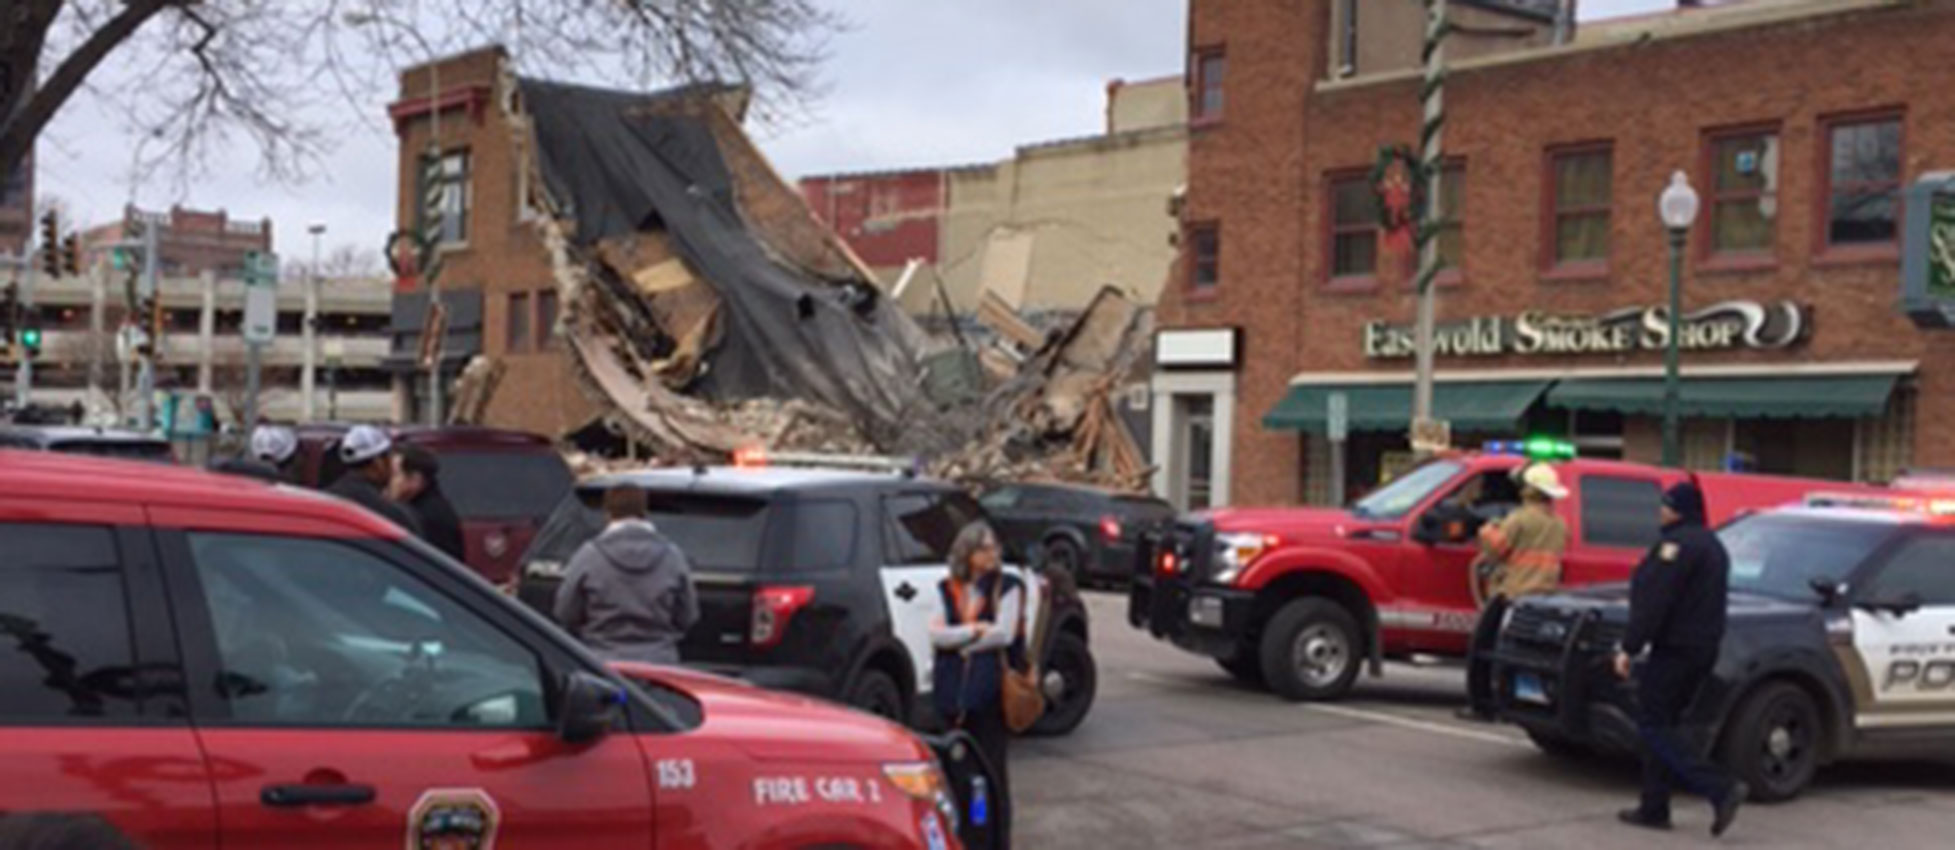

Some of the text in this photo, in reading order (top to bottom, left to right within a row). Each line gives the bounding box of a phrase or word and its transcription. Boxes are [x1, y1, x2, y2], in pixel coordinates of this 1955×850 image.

[1366, 317, 1501, 357] Easwold
[1514, 309, 1630, 353] SMOKE
[1640, 304, 1742, 350] SHOP
[656, 759, 696, 789] 153
[753, 776, 810, 805] FIRE
[815, 776, 864, 803] CAR
